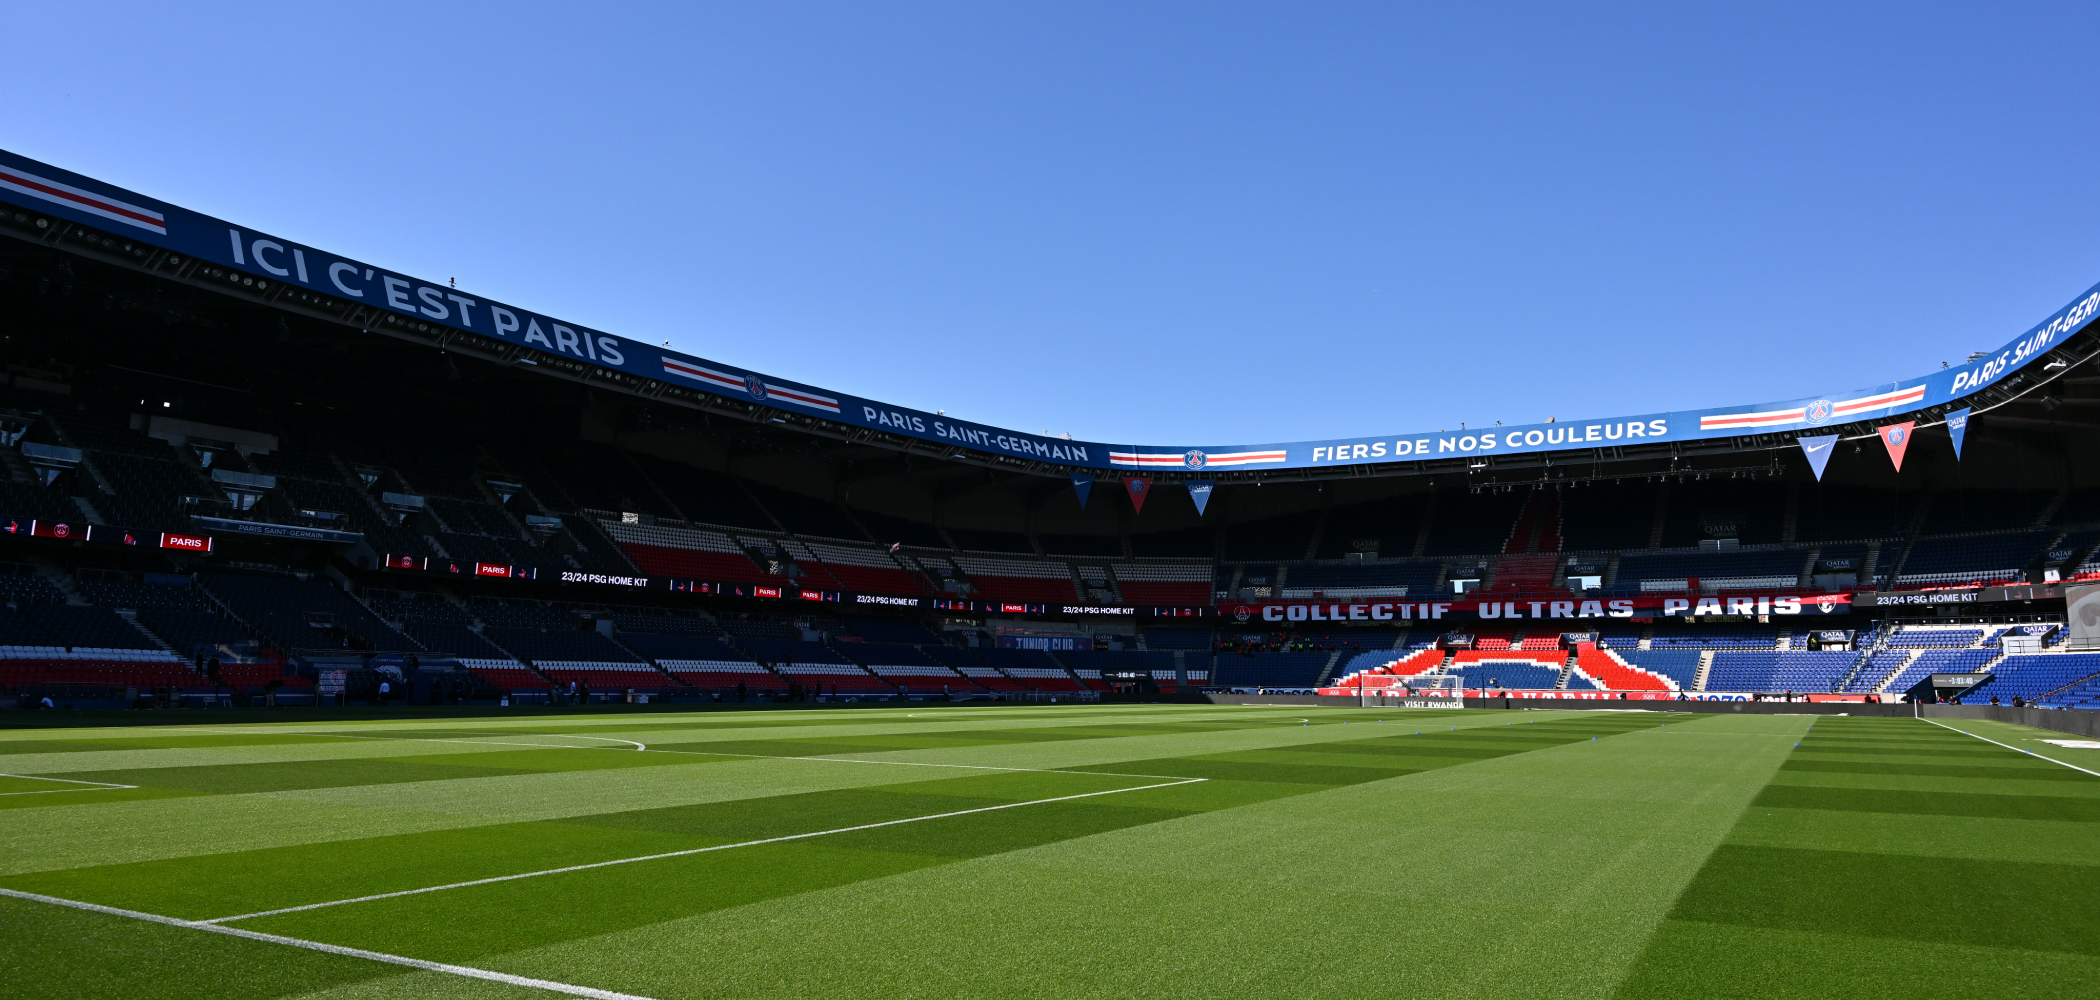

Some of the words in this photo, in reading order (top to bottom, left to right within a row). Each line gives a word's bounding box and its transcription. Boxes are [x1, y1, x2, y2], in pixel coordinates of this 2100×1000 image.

[229, 228, 309, 284] ICI
[329, 261, 477, 328] C'EST
[490, 304, 625, 366] PARIS
[1950, 350, 2010, 395] PARIS
[1948, 416, 1966, 427] QATAR
[862, 405, 926, 433] PARIS
[934, 421, 1089, 462] SAINT-GERMAIN
[1312, 442, 1387, 462] FIERS
[1396, 438, 1430, 456] DE
[1439, 434, 1496, 453] NOS
[1505, 418, 1668, 448] COULEURS
[238, 524, 263, 534] PARIS
[264, 527, 324, 539] SAINT-GERMAIN
[1705, 524, 1737, 533] QATAR
[169, 537, 202, 548] PARIS
[1353, 540, 1379, 548] QATAR
[2049, 550, 2073, 559] QATAR
[1826, 559, 1850, 567] QATAR
[482, 565, 505, 575] PARIS
[1574, 565, 1595, 573] QATAR
[561, 571, 587, 584] 23/24
[589, 574, 607, 584] PSG
[608, 575, 632, 586] HOME
[633, 577, 648, 588] KIT
[758, 588, 777, 597] PARIS
[802, 591, 819, 600] PARIS
[857, 595, 874, 604] 23/24
[875, 596, 888, 605] PSG
[889, 597, 907, 606] HOME
[907, 598, 918, 607] KIT
[1877, 596, 1905, 606] 23/24
[1907, 595, 1927, 604] PSG
[1929, 593, 1960, 603] HOME
[1962, 592, 1978, 602] KIT
[1063, 606, 1083, 614] 23/24
[1084, 606, 1099, 615] PSG
[1100, 607, 1121, 615] HOME
[1122, 607, 1135, 616] KIT
[1263, 602, 1452, 622] COLLECTIF
[1478, 599, 1634, 619] ULTRAS
[1664, 596, 1802, 617] PARIS
[2023, 625, 2048, 634] QATAR
[1569, 633, 1590, 641] QATAR
[1821, 631, 1845, 639] QATAR
[1016, 637, 1049, 652] JUNIOR
[1404, 700, 1425, 708] VISIT
[1427, 701, 1465, 709] RWANDA
